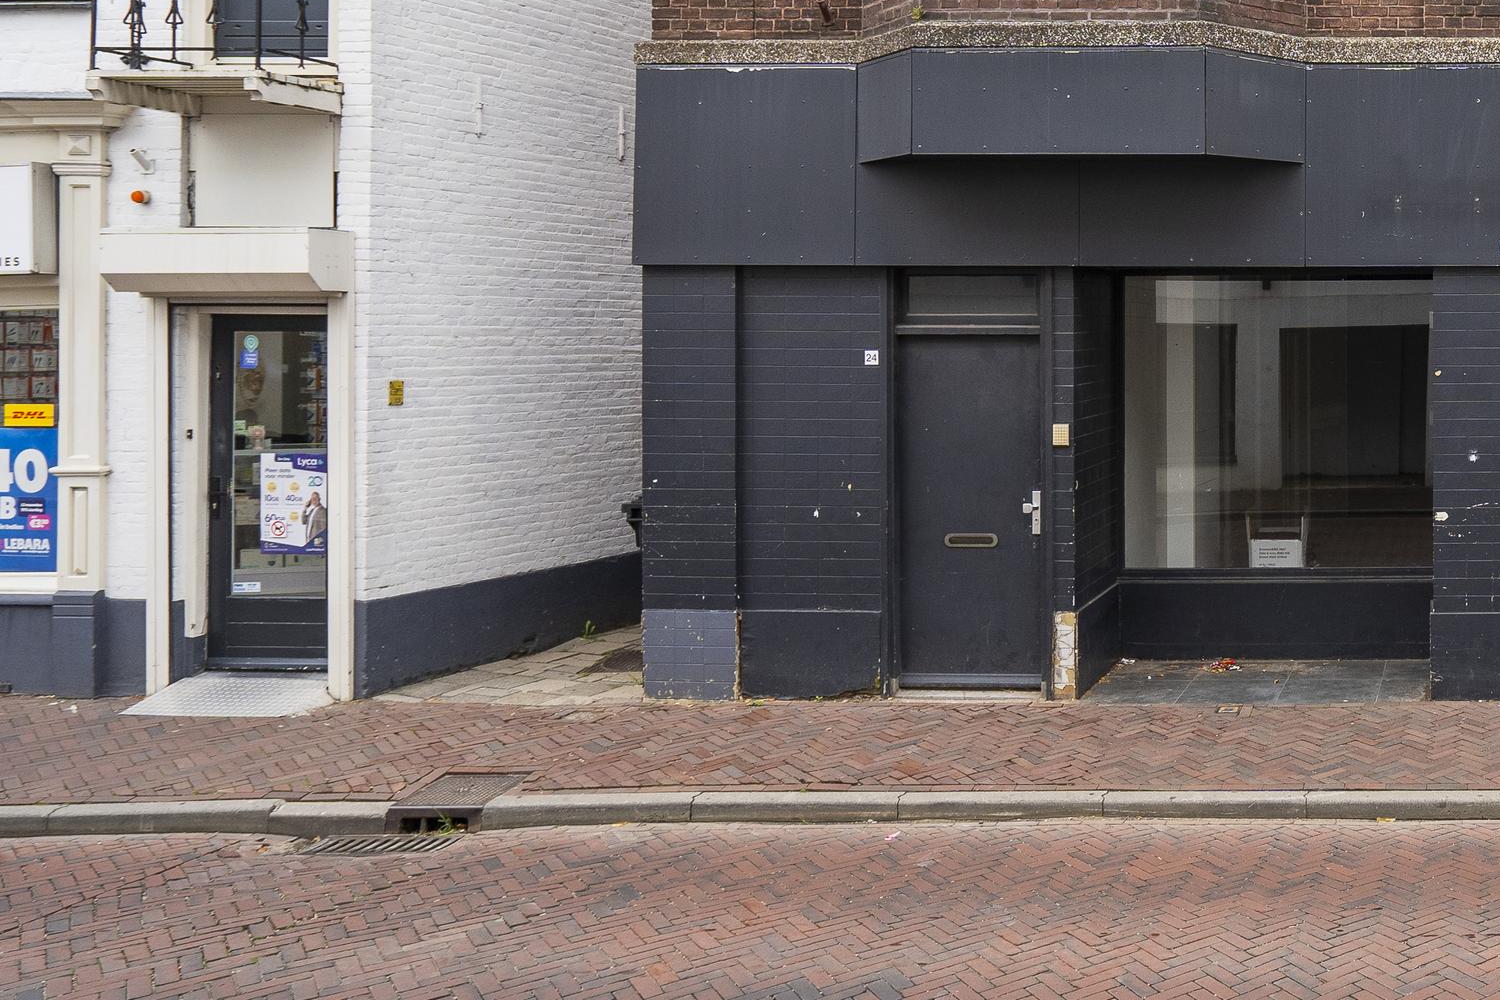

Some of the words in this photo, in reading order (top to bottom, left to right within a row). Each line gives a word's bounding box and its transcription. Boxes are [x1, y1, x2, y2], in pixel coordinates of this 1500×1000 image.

[866, 353, 877, 363] 24
[12, 411, 46, 419] DHL
[297, 457, 318, 467] Lyca
[4, 538, 51, 550] LEBARA
